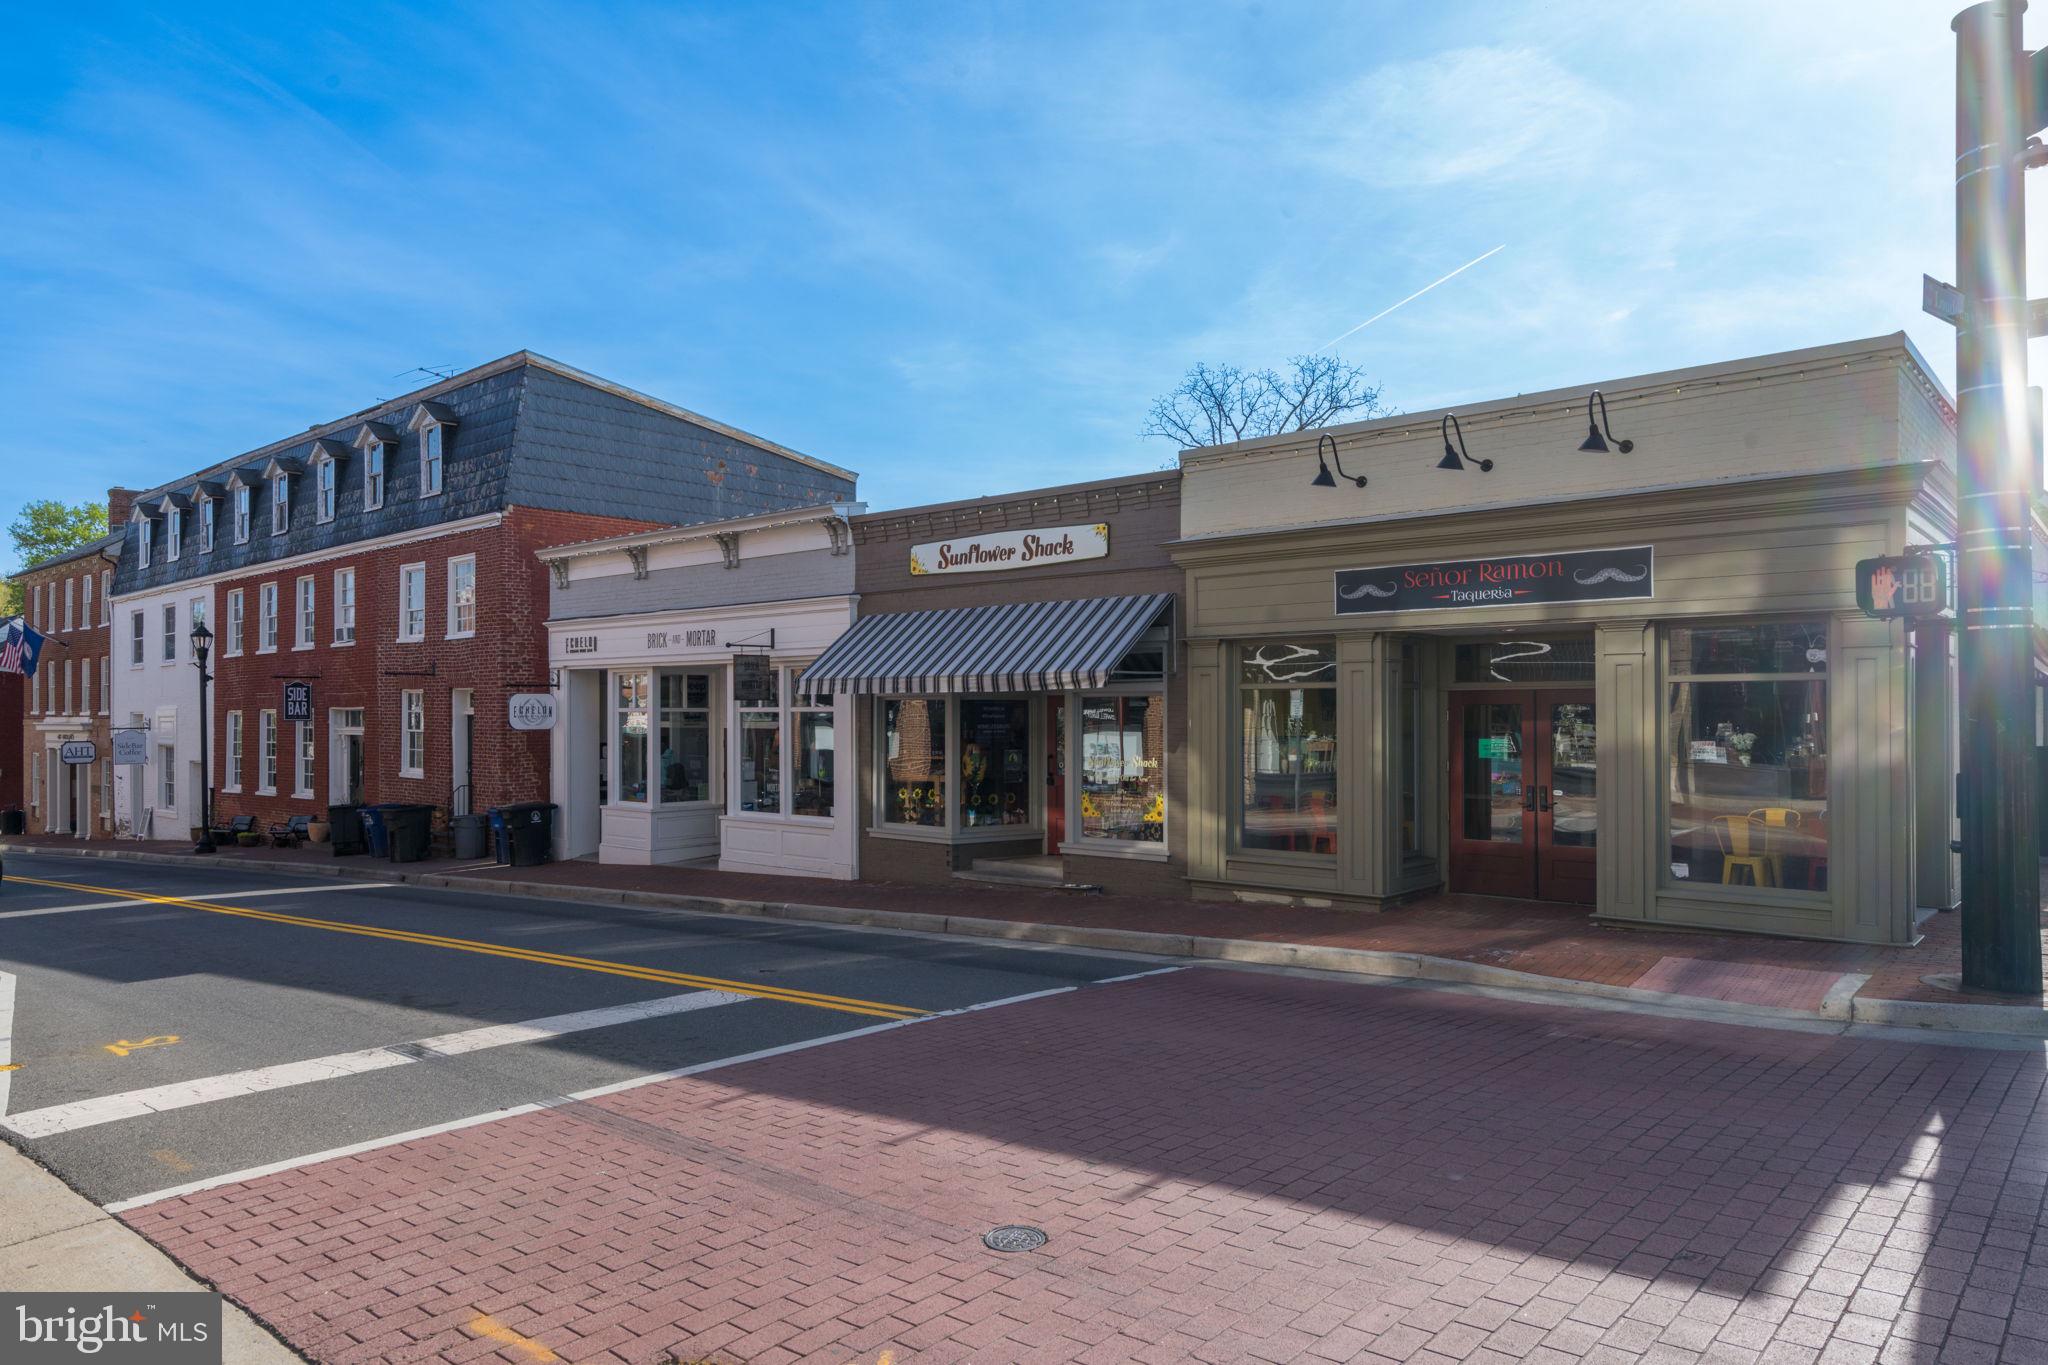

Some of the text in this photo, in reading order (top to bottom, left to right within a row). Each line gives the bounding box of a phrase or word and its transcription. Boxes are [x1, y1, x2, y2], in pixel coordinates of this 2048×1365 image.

[937, 533, 1074, 570] Sunflower Shack
[1403, 560, 1565, 589] Señor Ramon
[647, 632, 668, 649] BRICK
[686, 629, 717, 647] MORTAR
[287, 687, 308, 701] SIDE
[287, 701, 308, 715] BAR
[513, 705, 553, 719] ECHELON
[66, 746, 92, 756] AHT
[1131, 756, 1158, 768] Shack
